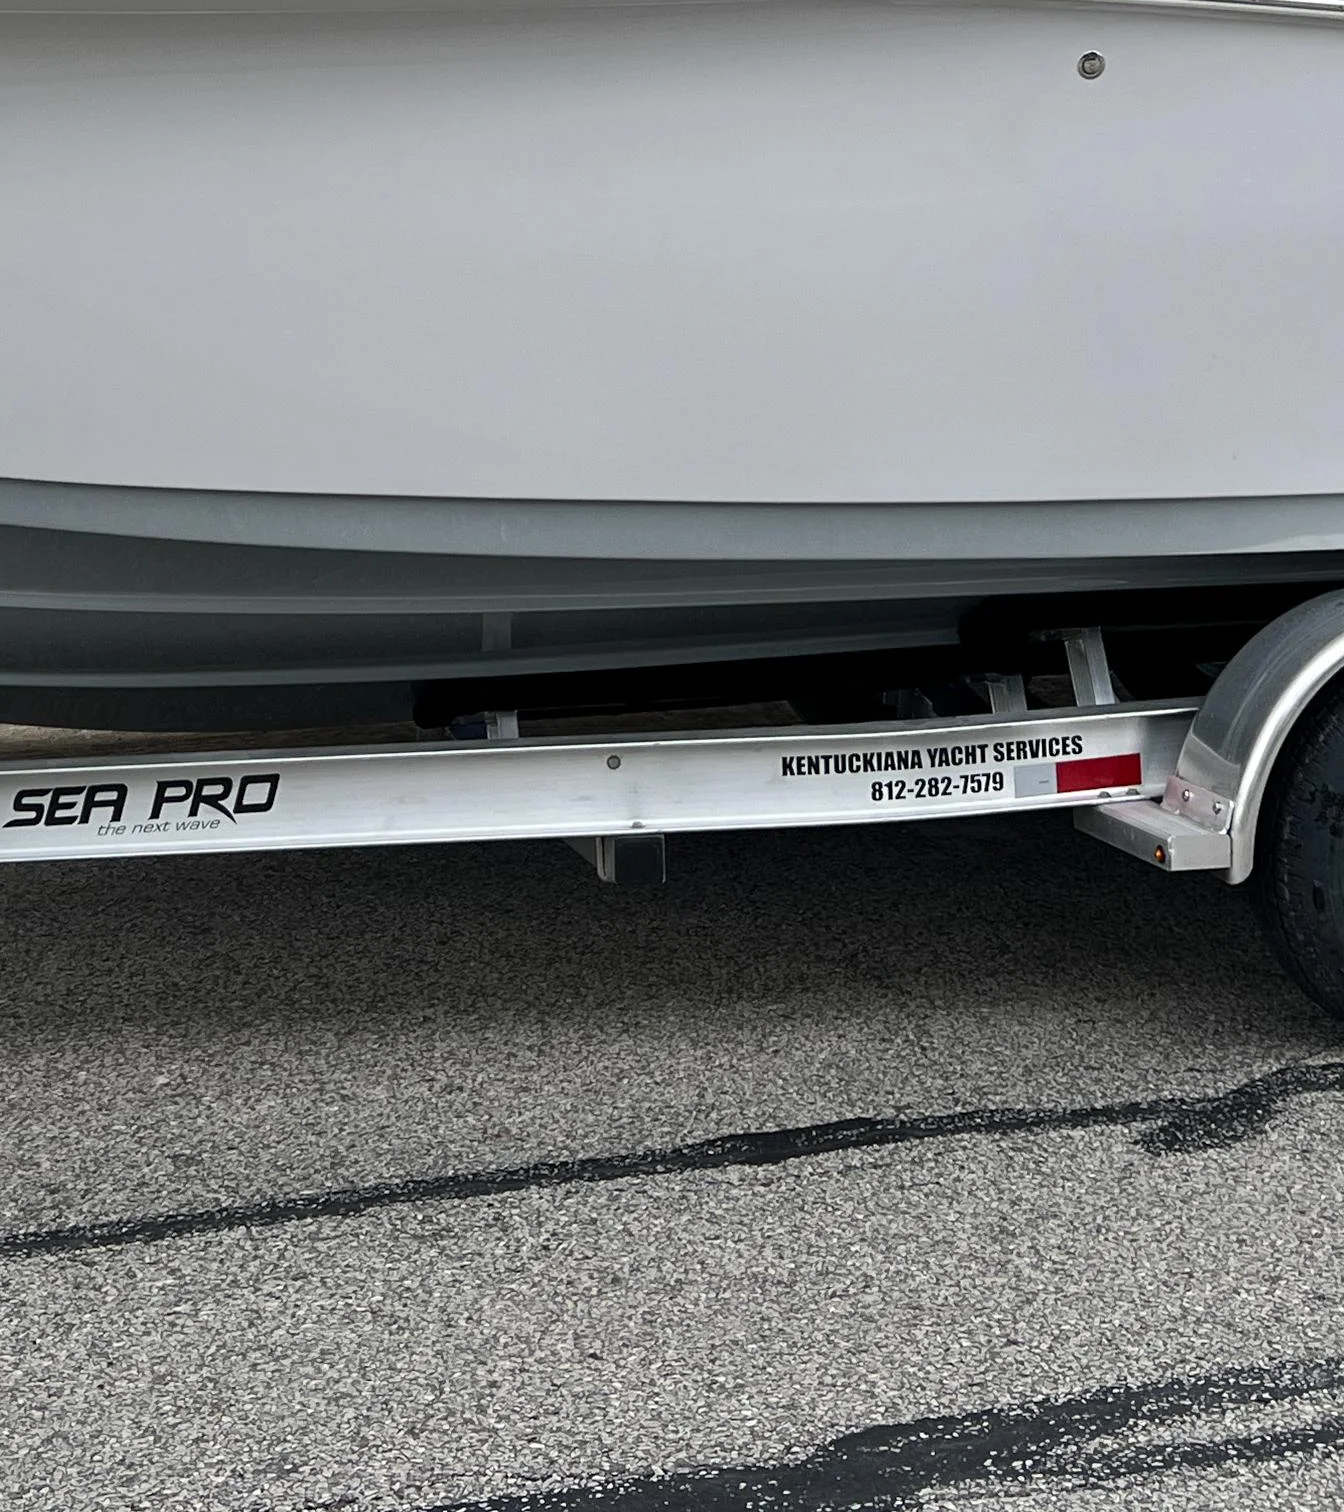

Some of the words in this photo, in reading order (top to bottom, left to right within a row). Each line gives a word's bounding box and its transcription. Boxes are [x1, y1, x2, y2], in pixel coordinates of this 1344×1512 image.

[781, 748, 923, 777] KENTUCKIANA
[926, 743, 989, 768] YACHT
[993, 734, 1084, 763] SERVICES
[2, 783, 129, 829] SEA
[148, 773, 281, 825] PRO
[870, 771, 1005, 802] 812-282-7579
[97, 822, 127, 837] the
[131, 821, 170, 835] next
[175, 818, 221, 831] wave
